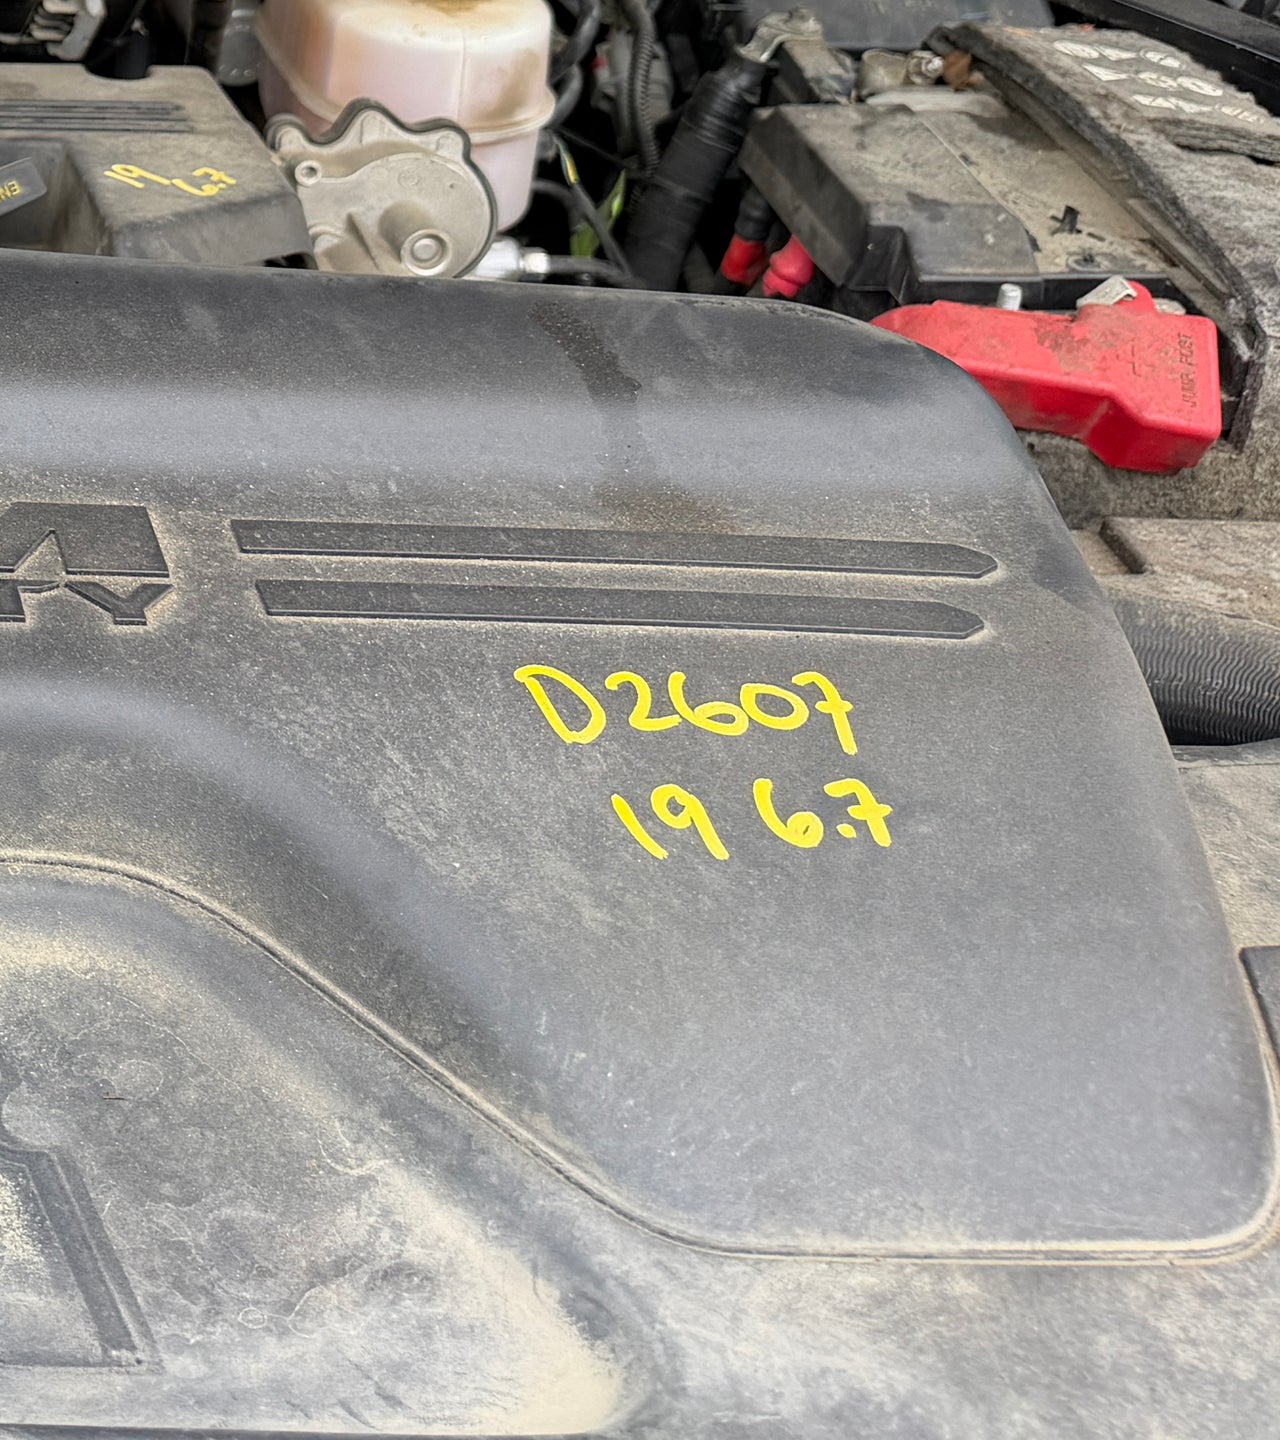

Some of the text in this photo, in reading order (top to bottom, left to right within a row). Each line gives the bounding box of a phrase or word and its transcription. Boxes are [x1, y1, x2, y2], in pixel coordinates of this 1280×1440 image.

[514, 664, 858, 756] D2607
[611, 778, 893, 860] 19 6.7
